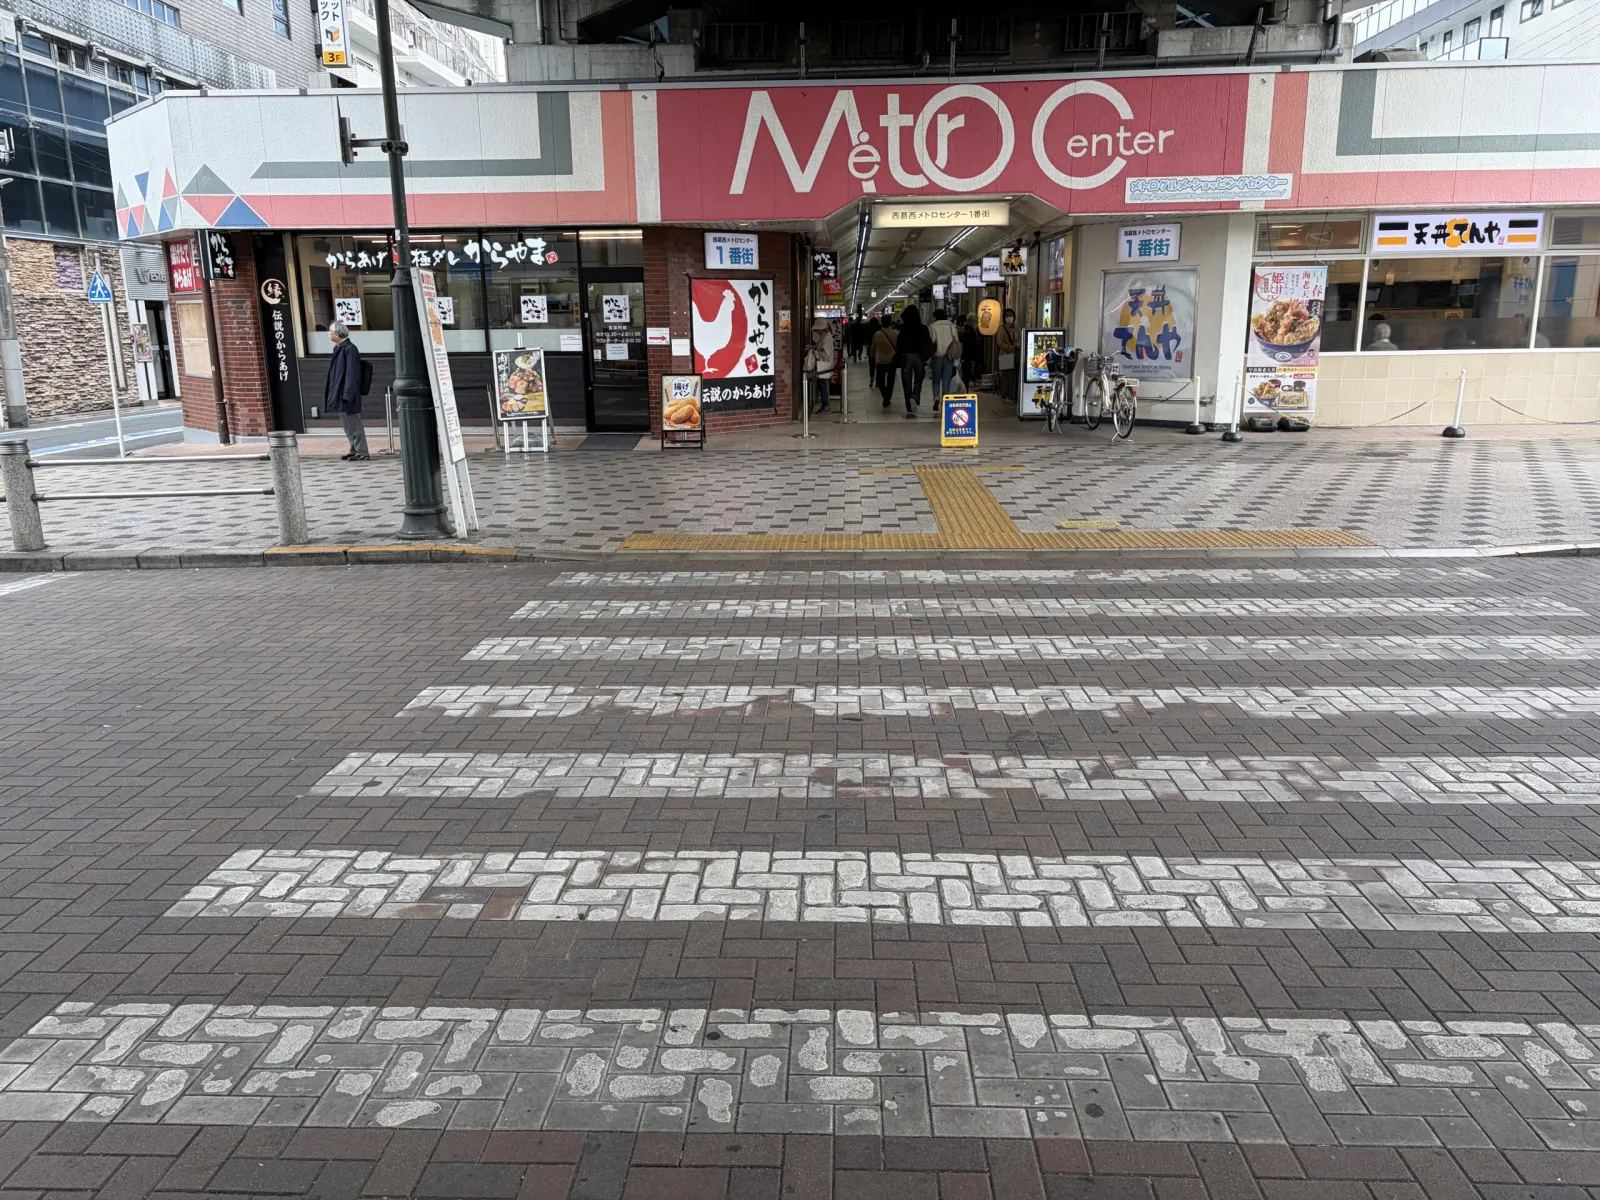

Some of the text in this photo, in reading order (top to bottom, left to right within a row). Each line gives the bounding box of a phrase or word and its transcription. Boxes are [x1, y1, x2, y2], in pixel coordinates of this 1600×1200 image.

[327, 52, 341, 63] 3F
[1032, 79, 1175, 190] Center
[712, 236, 754, 244] 西葛西メトロセンター
[1123, 228, 1172, 237] 西葛西メトロセンター
[1413, 220, 1501, 245] 天丼てんや
[325, 250, 389, 269] からあげ
[463, 237, 548, 269] からやま
[715, 245, 754, 266] 1番街
[1125, 238, 1171, 258] 1番街
[173, 267, 193, 288] からあげ
[1128, 283, 1171, 317] 天丼
[748, 281, 772, 374] からやま
[271, 309, 289, 382] 伝説のからあげ
[1113, 323, 1182, 361] てんや
[673, 382, 691, 391] 揚げ
